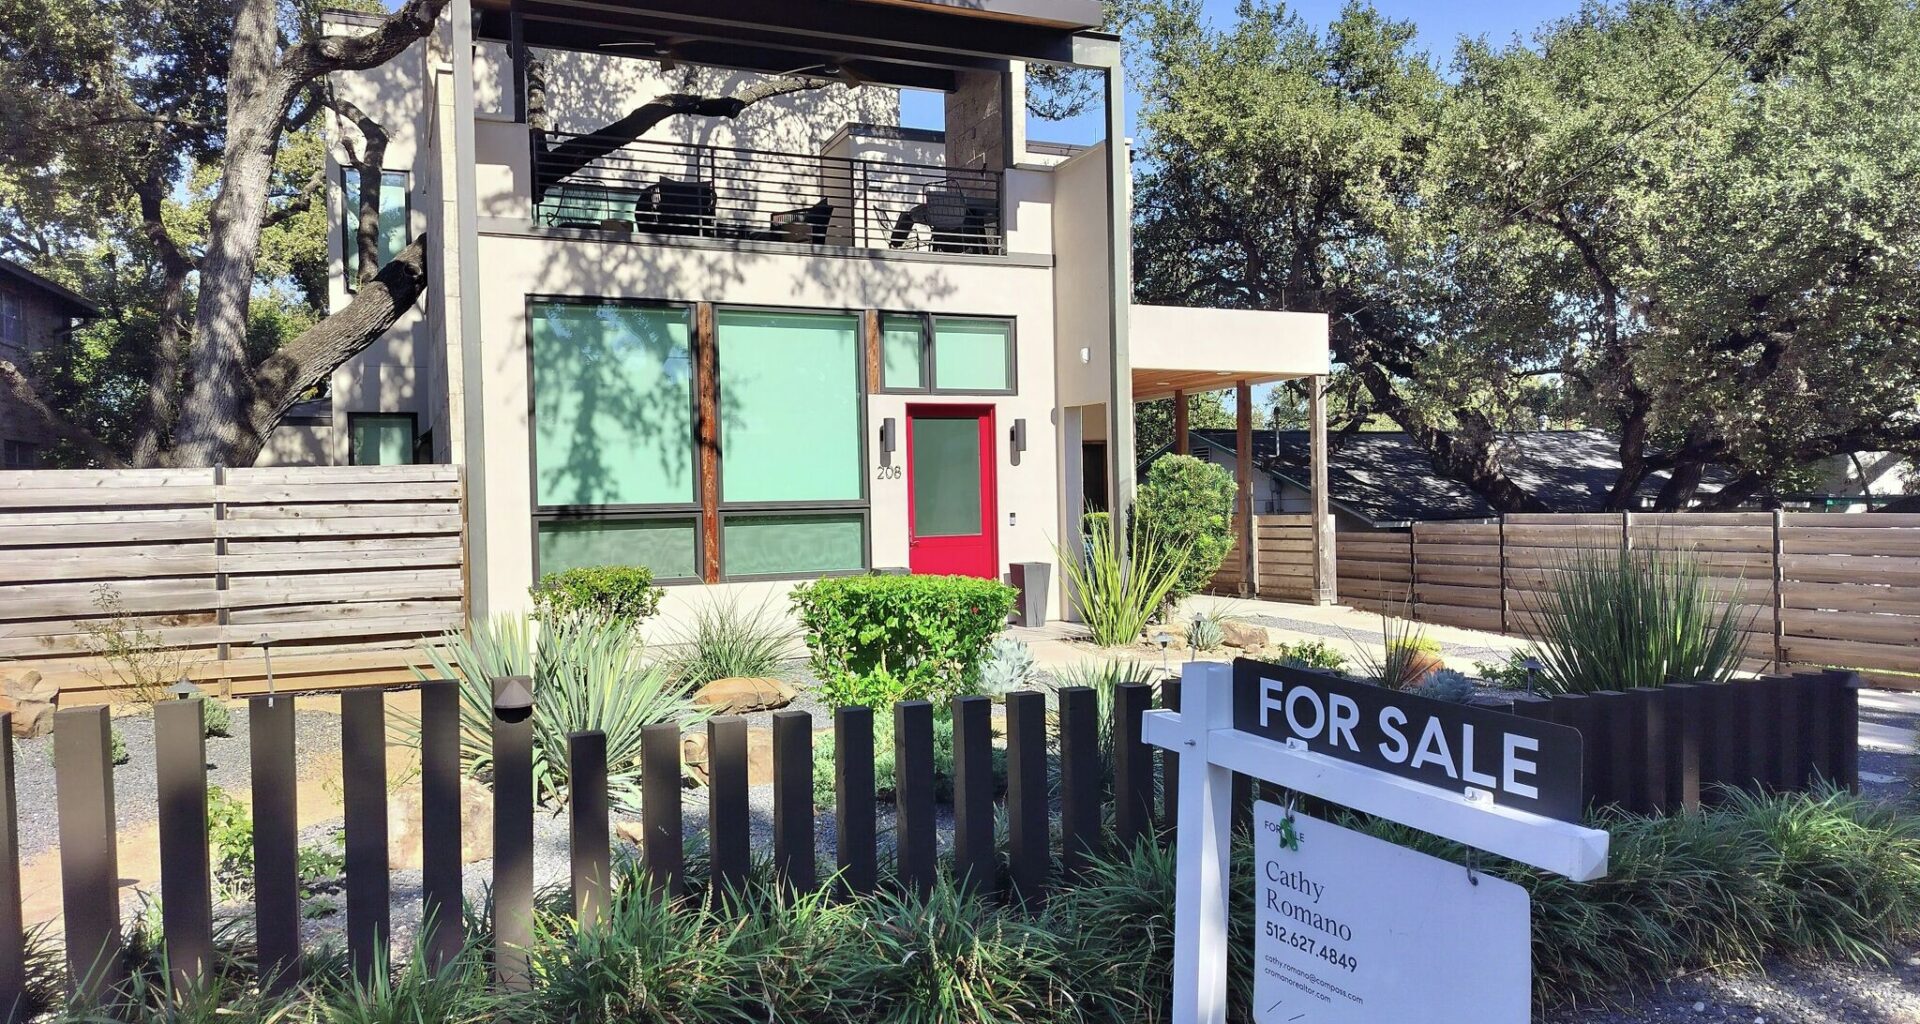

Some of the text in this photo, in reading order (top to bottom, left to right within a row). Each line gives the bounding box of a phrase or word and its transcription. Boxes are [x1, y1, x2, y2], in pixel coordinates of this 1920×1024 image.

[877, 465, 901, 479] 208
[1259, 677, 1539, 799] FOR SALE
[1264, 820, 1283, 834] FOR
[1266, 860, 1325, 904] Cathy
[1266, 888, 1352, 942] Romano
[1265, 920, 1358, 973] 512.627.4849
[1264, 954, 1364, 1005] cathy.romano@compass.com
[1264, 966, 1332, 1003] cromanorealtor.com
